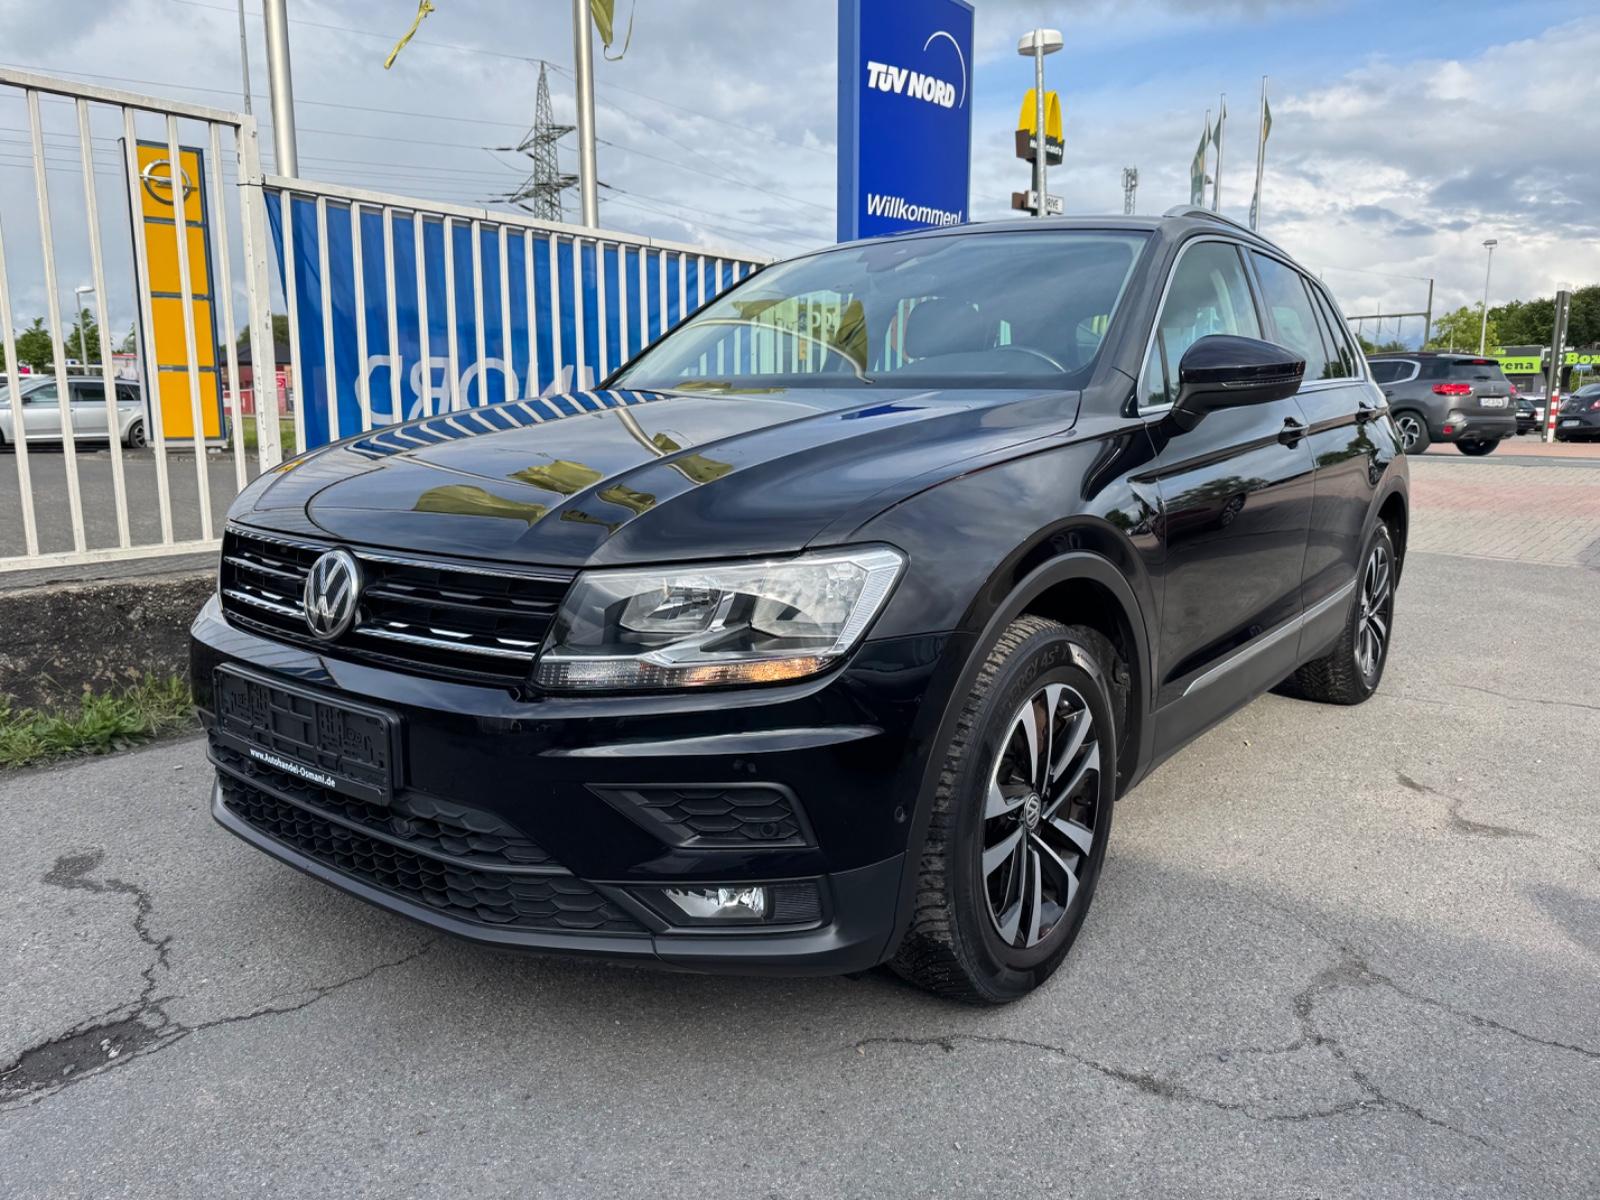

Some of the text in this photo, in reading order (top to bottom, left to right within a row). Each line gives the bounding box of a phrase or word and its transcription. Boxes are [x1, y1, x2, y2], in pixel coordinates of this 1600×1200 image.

[867, 61, 955, 108] TÜV NORD
[867, 193, 962, 226] Willkommen!
[250, 748, 336, 788] www.Autohandel-Osmani.de
